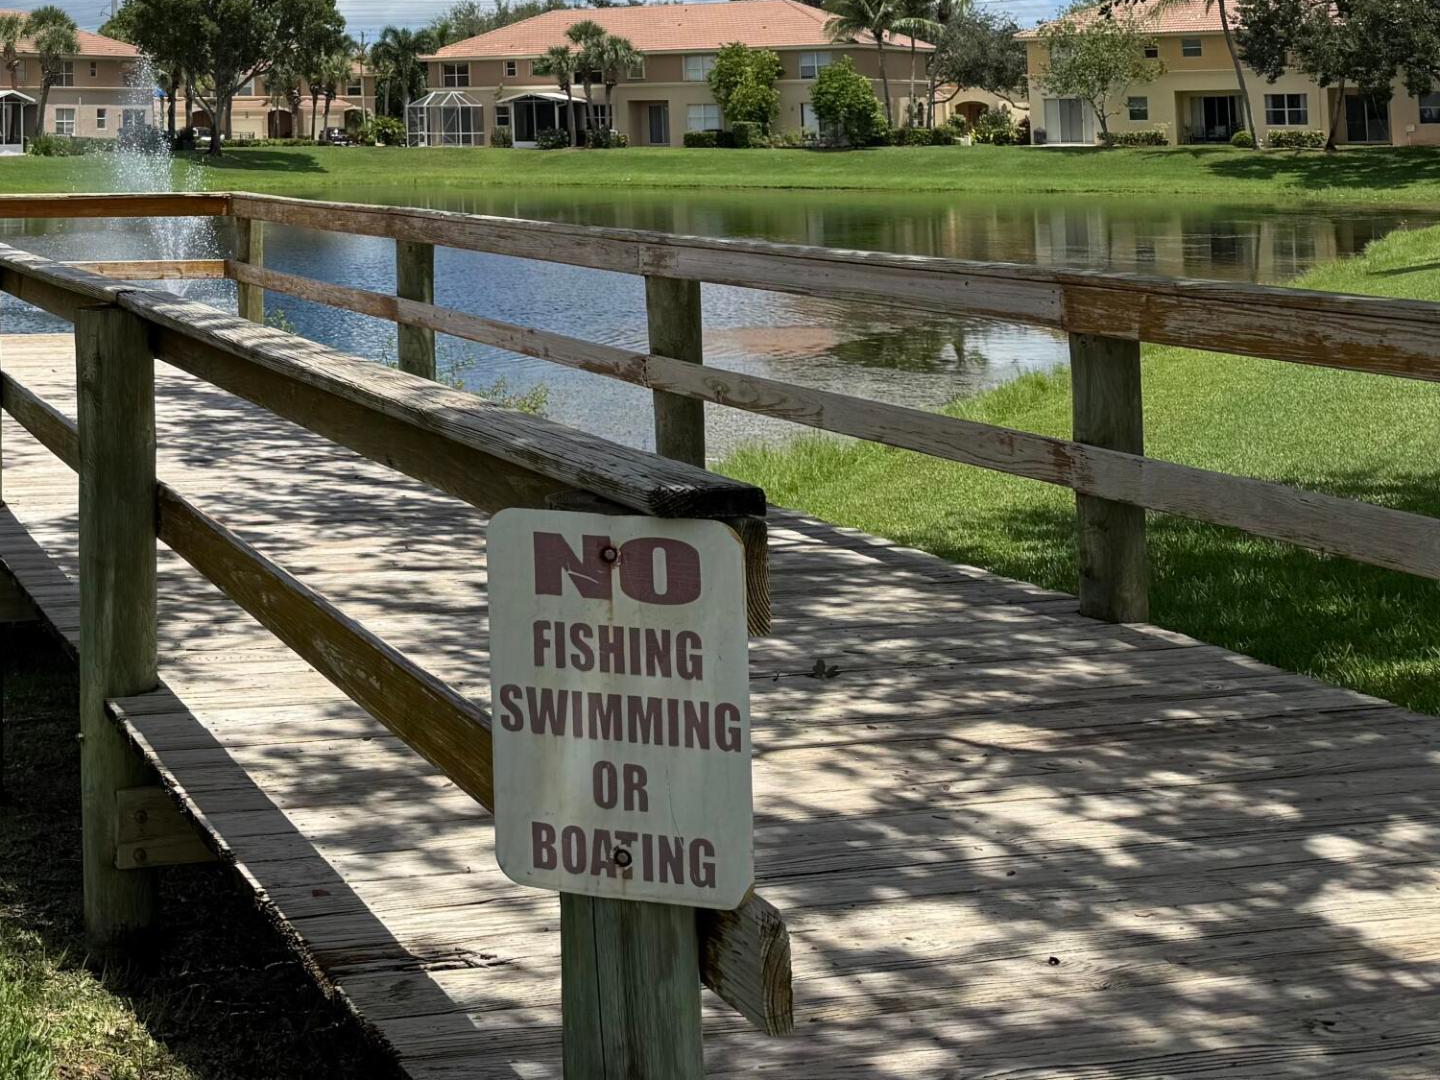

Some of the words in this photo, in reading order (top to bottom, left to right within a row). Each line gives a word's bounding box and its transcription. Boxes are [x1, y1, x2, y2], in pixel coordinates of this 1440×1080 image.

[533, 531, 701, 605] NO
[533, 620, 703, 680] FISHING
[500, 684, 741, 752] SWIMMING
[593, 760, 648, 812] OR
[532, 821, 715, 888] BOATING
